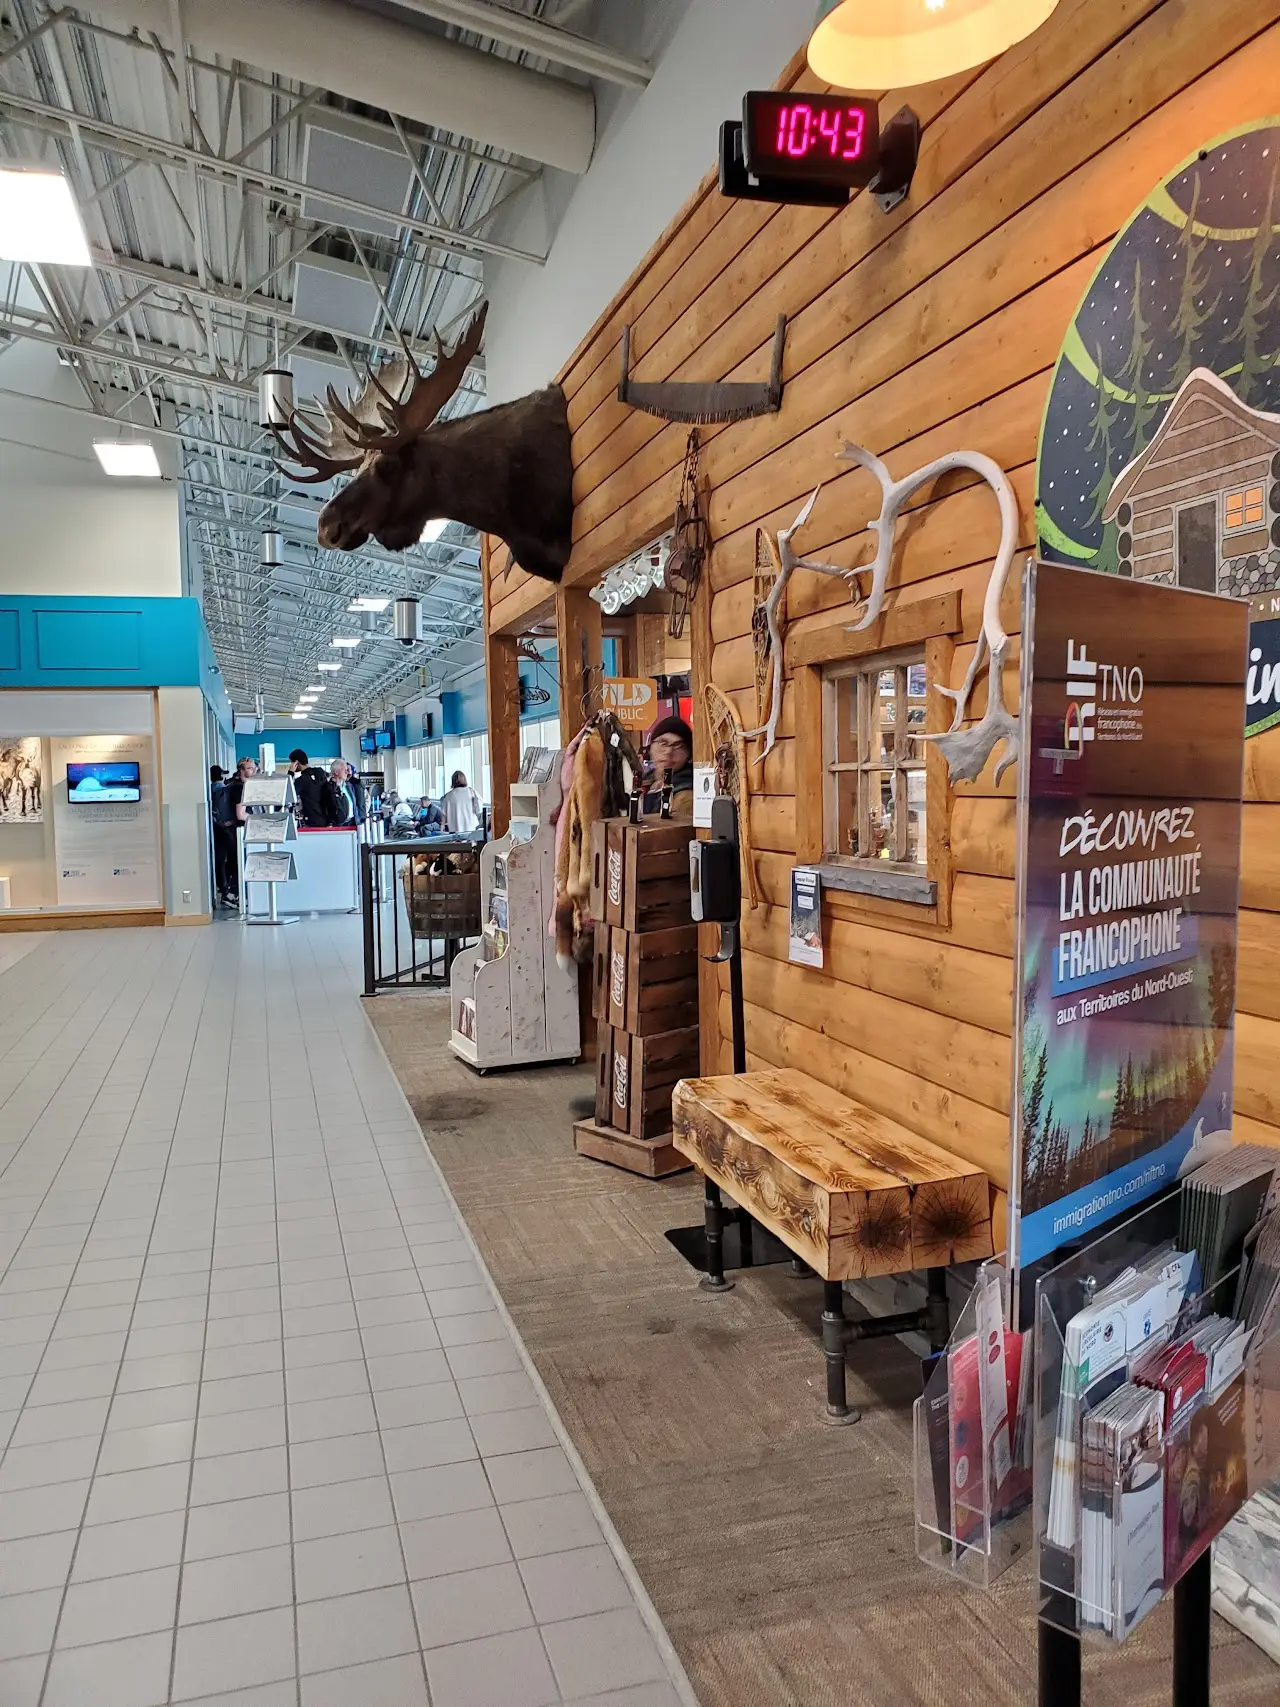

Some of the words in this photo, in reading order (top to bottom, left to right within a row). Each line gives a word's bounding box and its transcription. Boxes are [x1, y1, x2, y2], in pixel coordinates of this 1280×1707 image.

[777, 104, 865, 158] 10:43
[1098, 664, 1144, 704] TNO
[1097, 716, 1136, 732] francophone
[1059, 806, 1195, 858] DÉCOUVREZ
[1060, 869, 1084, 922] LA
[1088, 843, 1202, 916] COMMUNAUTÉ
[1058, 907, 1183, 982] FRANCOPHONE
[1056, 1007, 1077, 1026] aux
[1079, 990, 1130, 1018] Territoires
[1131, 985, 1143, 1003] du
[1144, 968, 1194, 998] Nord-Ouest
